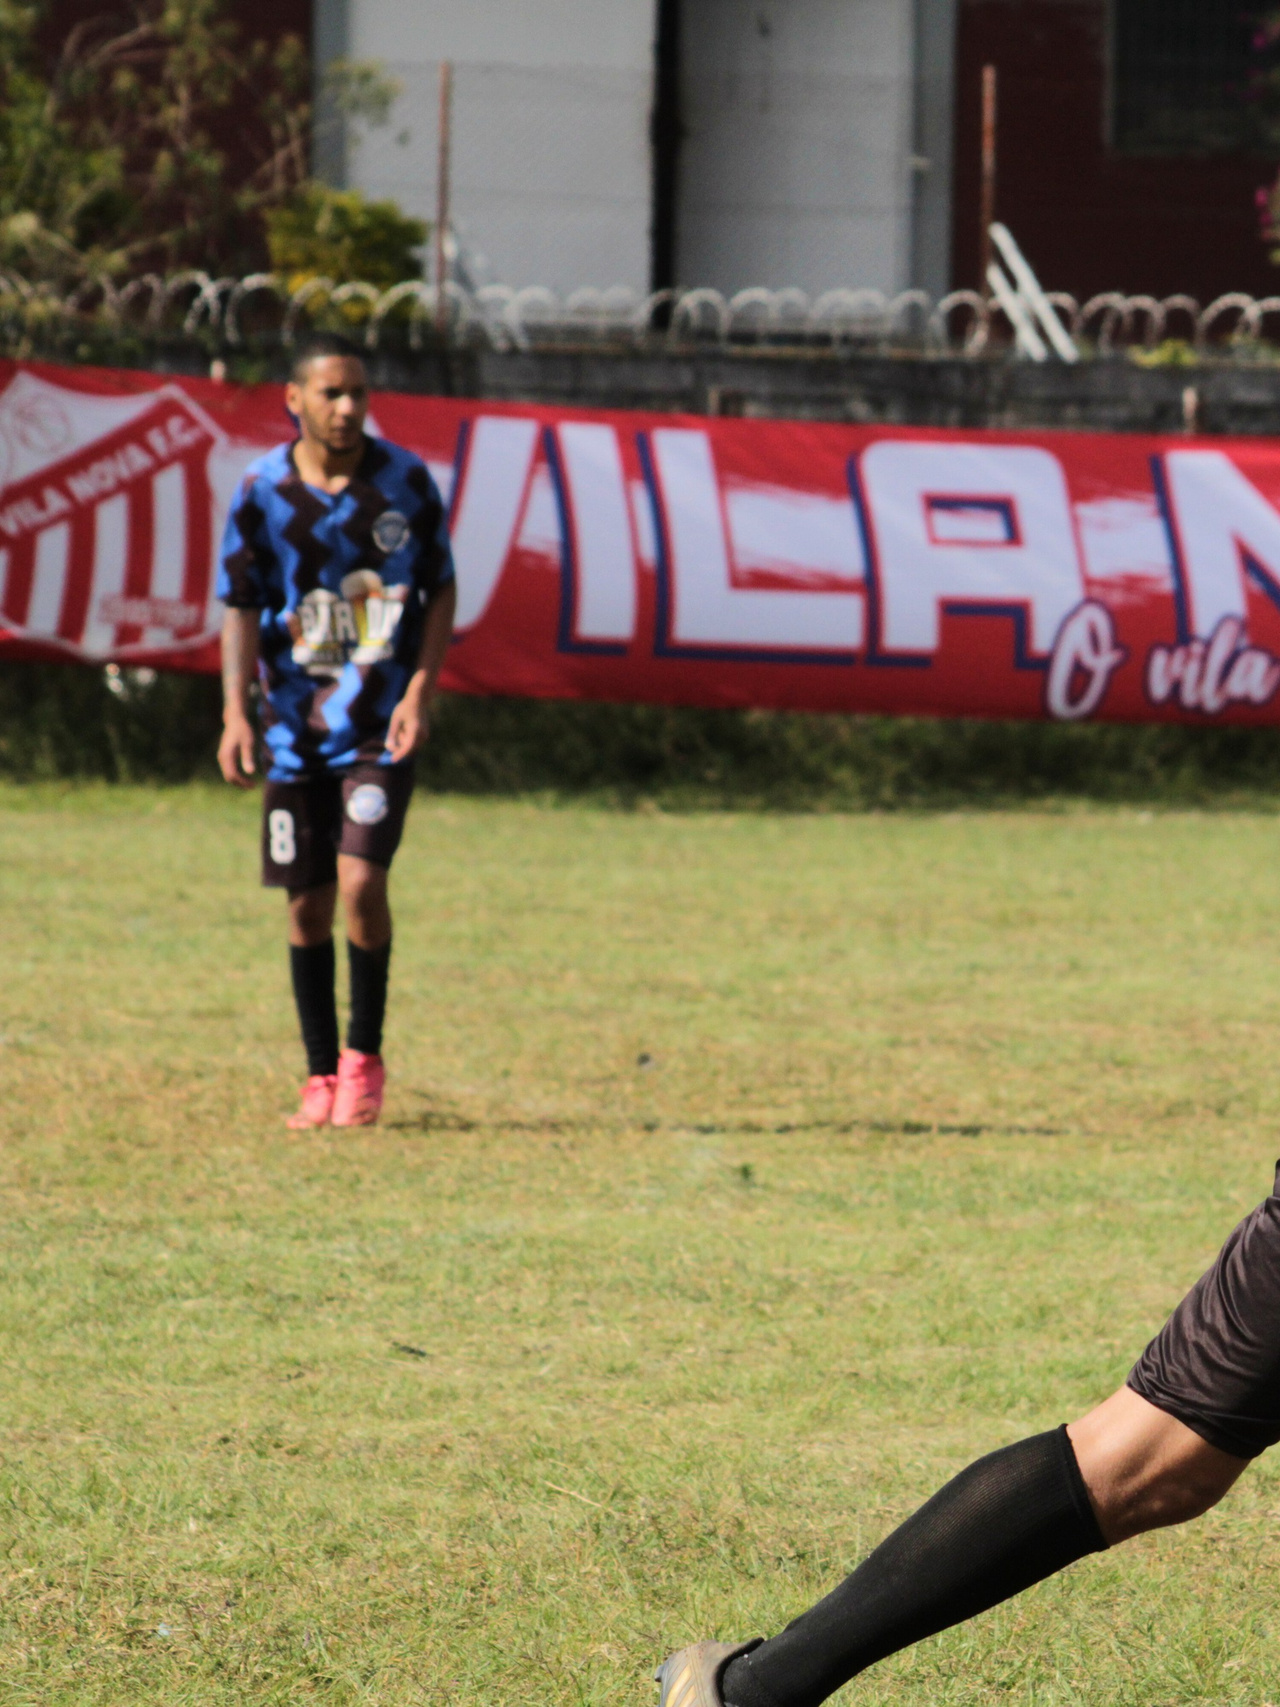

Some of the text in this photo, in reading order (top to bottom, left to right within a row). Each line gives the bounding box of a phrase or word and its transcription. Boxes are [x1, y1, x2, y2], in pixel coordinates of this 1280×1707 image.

[1, 487, 73, 538] VILA
[65, 443, 155, 504] NOVA
[269, 808, 297, 866] 8
